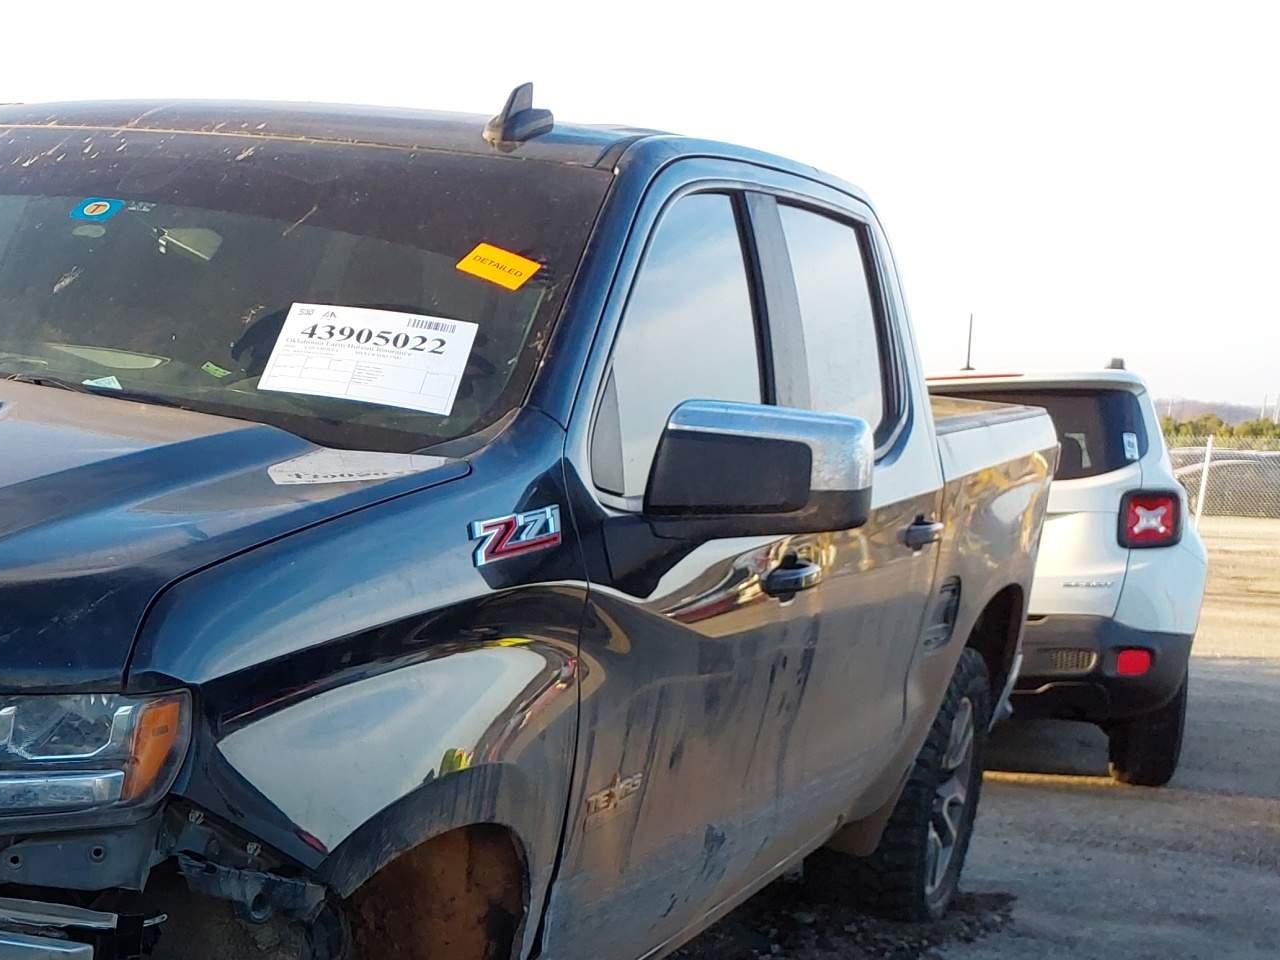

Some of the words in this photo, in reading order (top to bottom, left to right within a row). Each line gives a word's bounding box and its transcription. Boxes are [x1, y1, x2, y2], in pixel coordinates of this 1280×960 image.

[473, 254, 523, 277] DETAILED
[300, 323, 447, 355] 43905022
[468, 504, 561, 567] Z71
